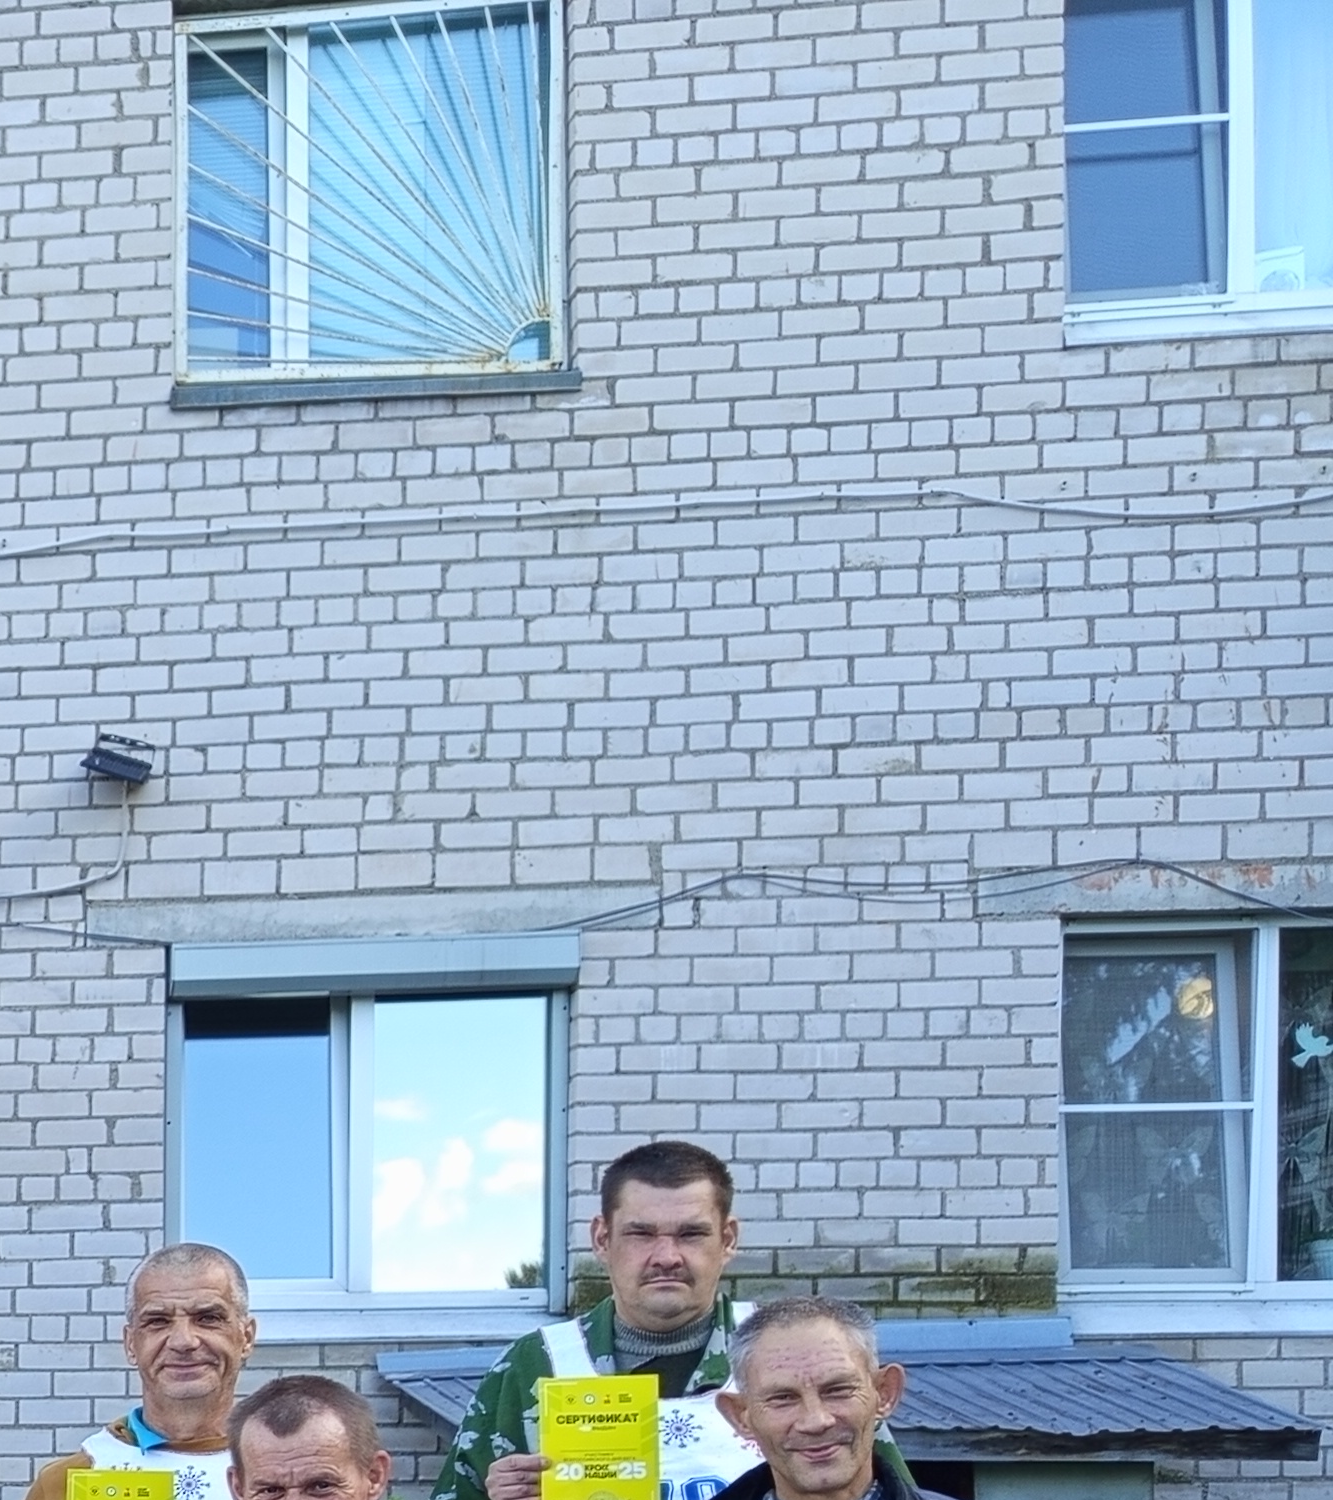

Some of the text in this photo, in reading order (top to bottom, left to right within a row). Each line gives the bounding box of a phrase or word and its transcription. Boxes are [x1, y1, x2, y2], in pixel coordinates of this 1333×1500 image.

[556, 1413, 639, 1424] СЕРТИФИКАТ
[555, 1462, 583, 1480] 20
[618, 1461, 646, 1479] 25
